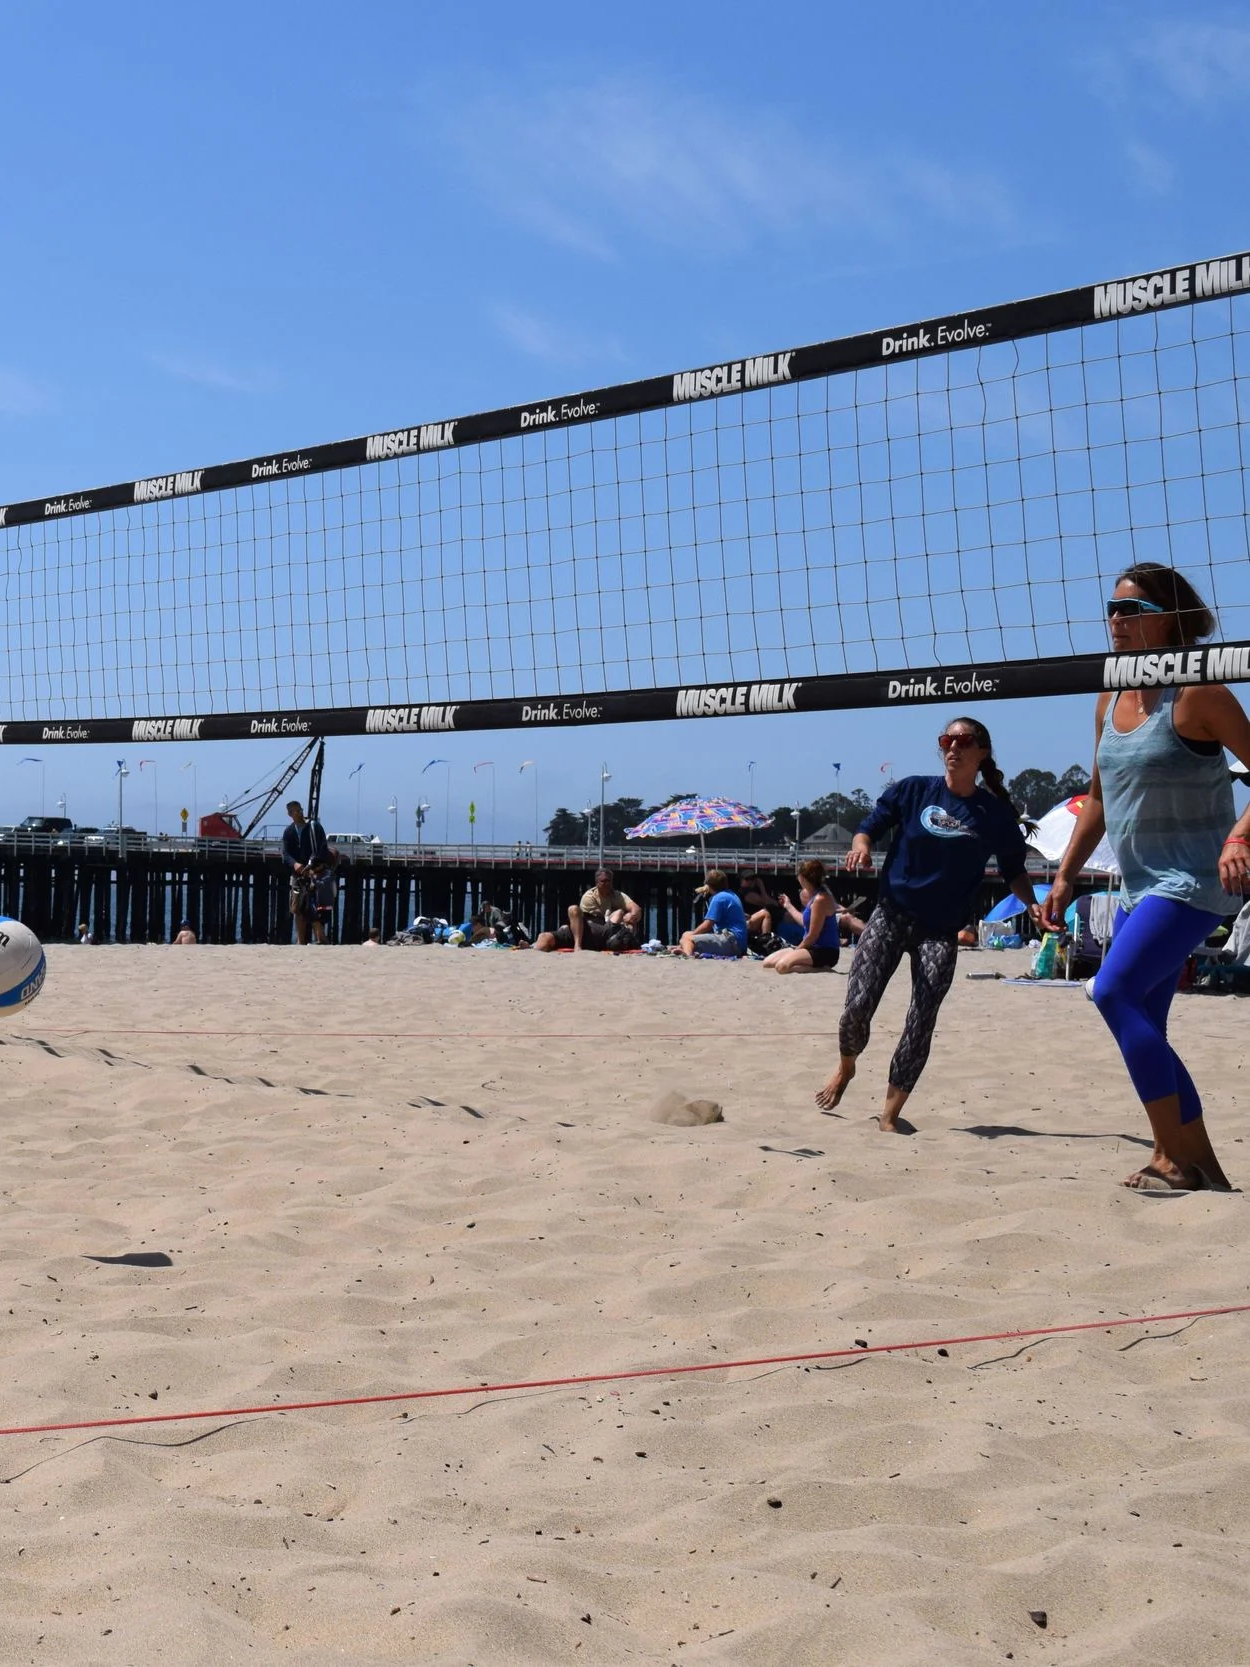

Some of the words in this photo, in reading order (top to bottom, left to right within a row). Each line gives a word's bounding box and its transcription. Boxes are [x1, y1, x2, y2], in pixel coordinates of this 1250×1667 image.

[1094, 269, 1190, 319] MUSCLE
[673, 362, 742, 401] MUSCLE
[744, 353, 792, 387] MILK
[366, 430, 418, 460] MUSCLE
[419, 423, 455, 450] MILK
[134, 476, 173, 503] MUSCLE
[174, 471, 202, 495] MILK
[1103, 650, 1203, 688] MUSCLE
[676, 686, 748, 717] MUSCLE
[749, 683, 798, 711] MILK
[132, 719, 172, 741] MUSCLE
[173, 719, 201, 740] MILK
[365, 708, 418, 733] MUSCLE
[419, 705, 456, 730] MILK
